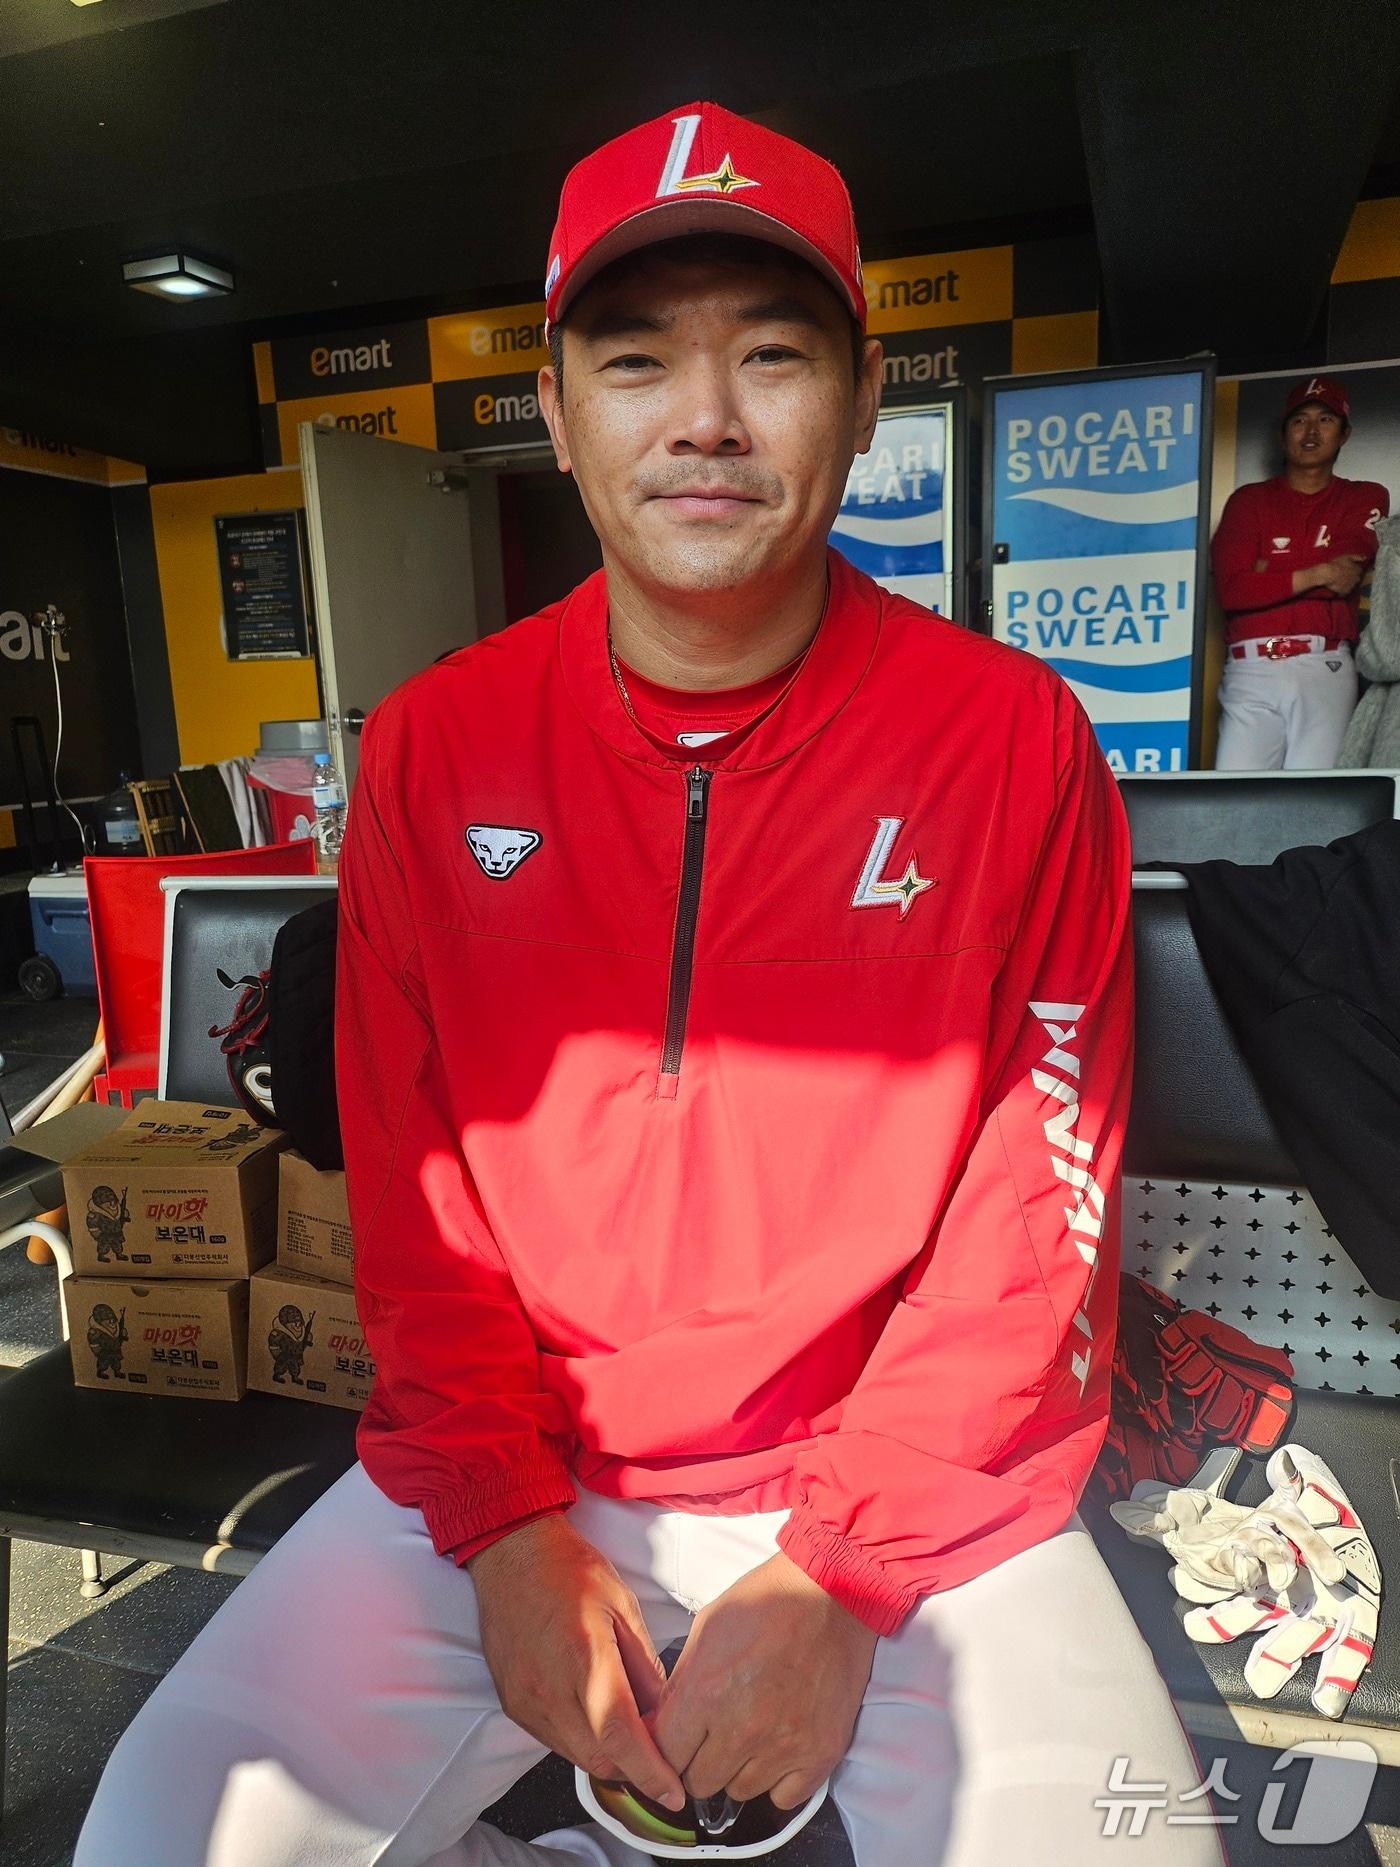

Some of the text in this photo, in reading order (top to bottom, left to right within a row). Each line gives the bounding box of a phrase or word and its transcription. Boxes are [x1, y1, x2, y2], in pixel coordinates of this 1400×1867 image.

[311, 339, 392, 376] emart
[474, 394, 544, 425] ema
[1008, 403, 1194, 450] POCARI
[1007, 438, 1177, 483] SWEAT
[1007, 581, 1187, 619] POCARI
[1007, 614, 1170, 648] SWEAT
[156, 1226, 206, 1244] 보온대
[151, 1348, 199, 1369] 보온대
[328, 1333, 371, 1357] 마이
